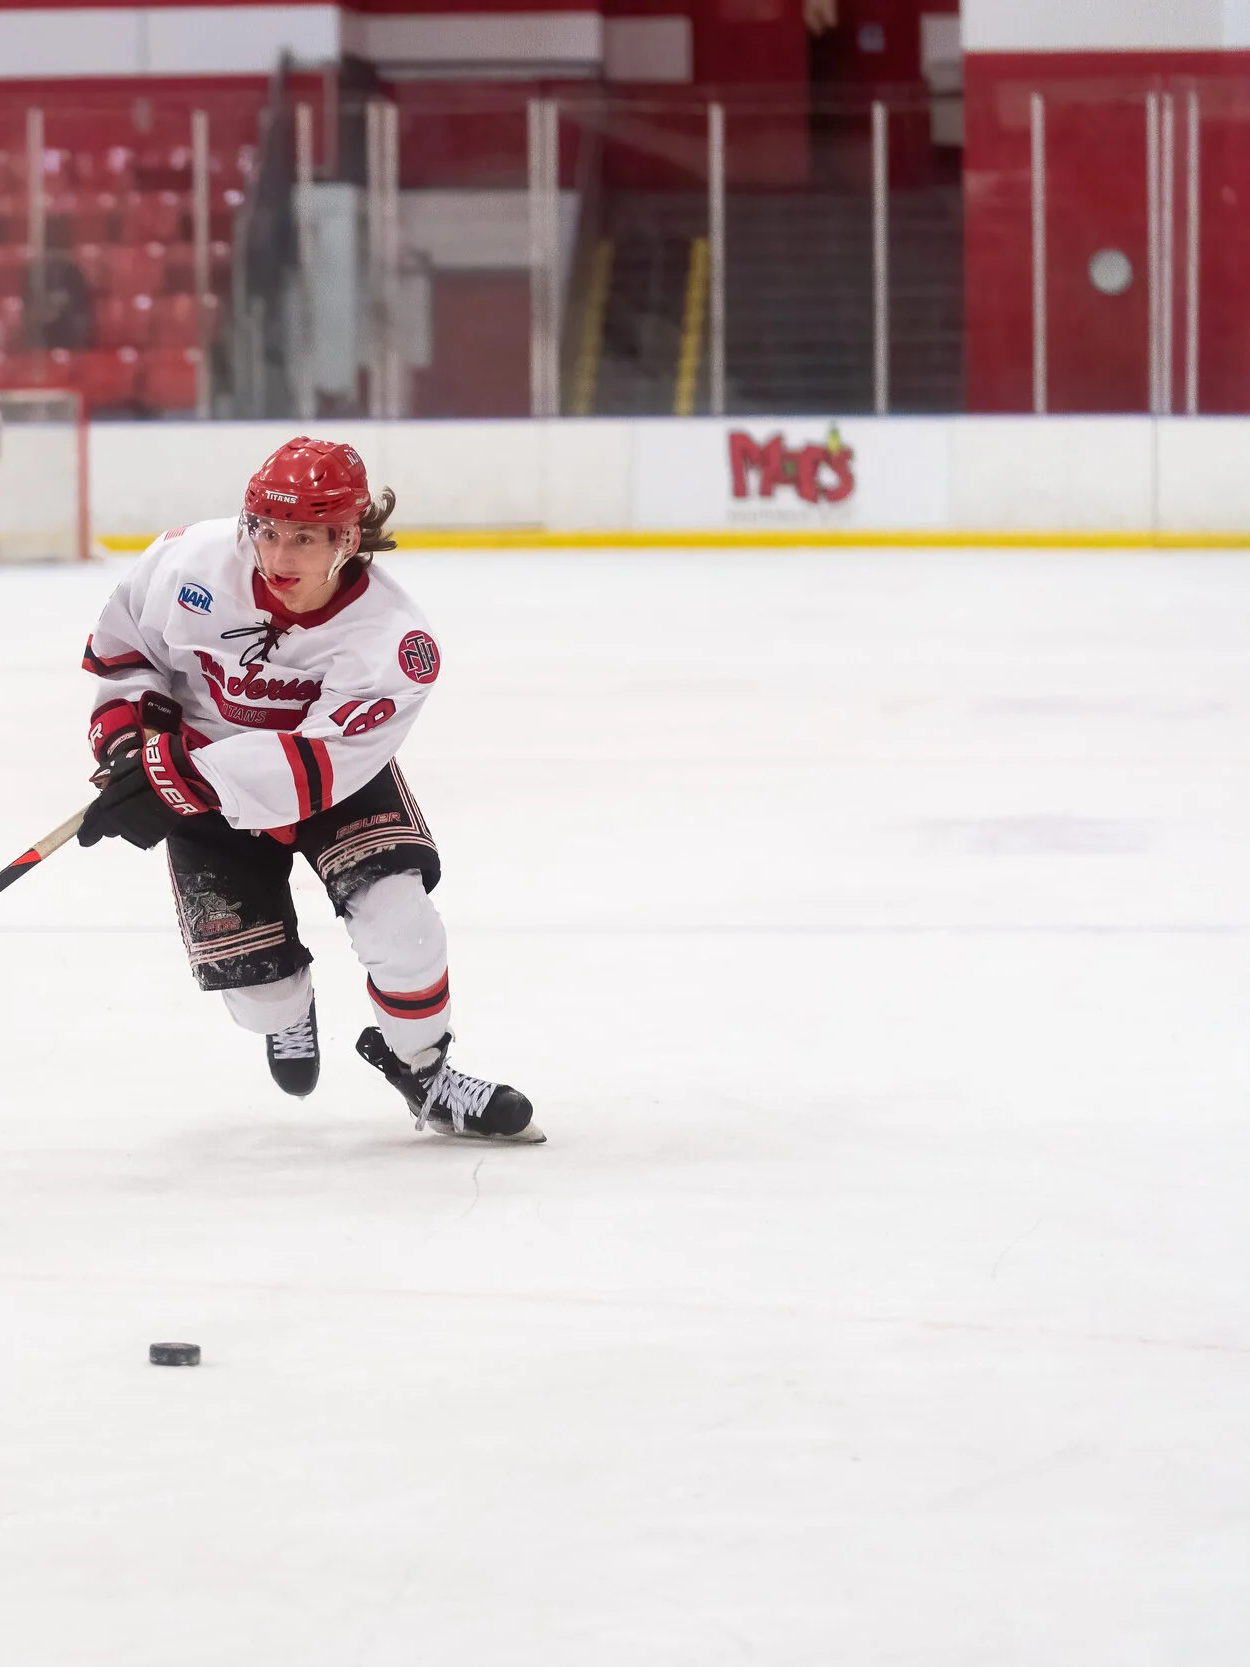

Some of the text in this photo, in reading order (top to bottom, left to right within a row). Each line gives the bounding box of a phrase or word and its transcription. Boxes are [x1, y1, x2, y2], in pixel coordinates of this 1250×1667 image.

[266, 489, 298, 504] TITANS
[178, 586, 212, 613] NAHL
[146, 733, 199, 815] BAUER
